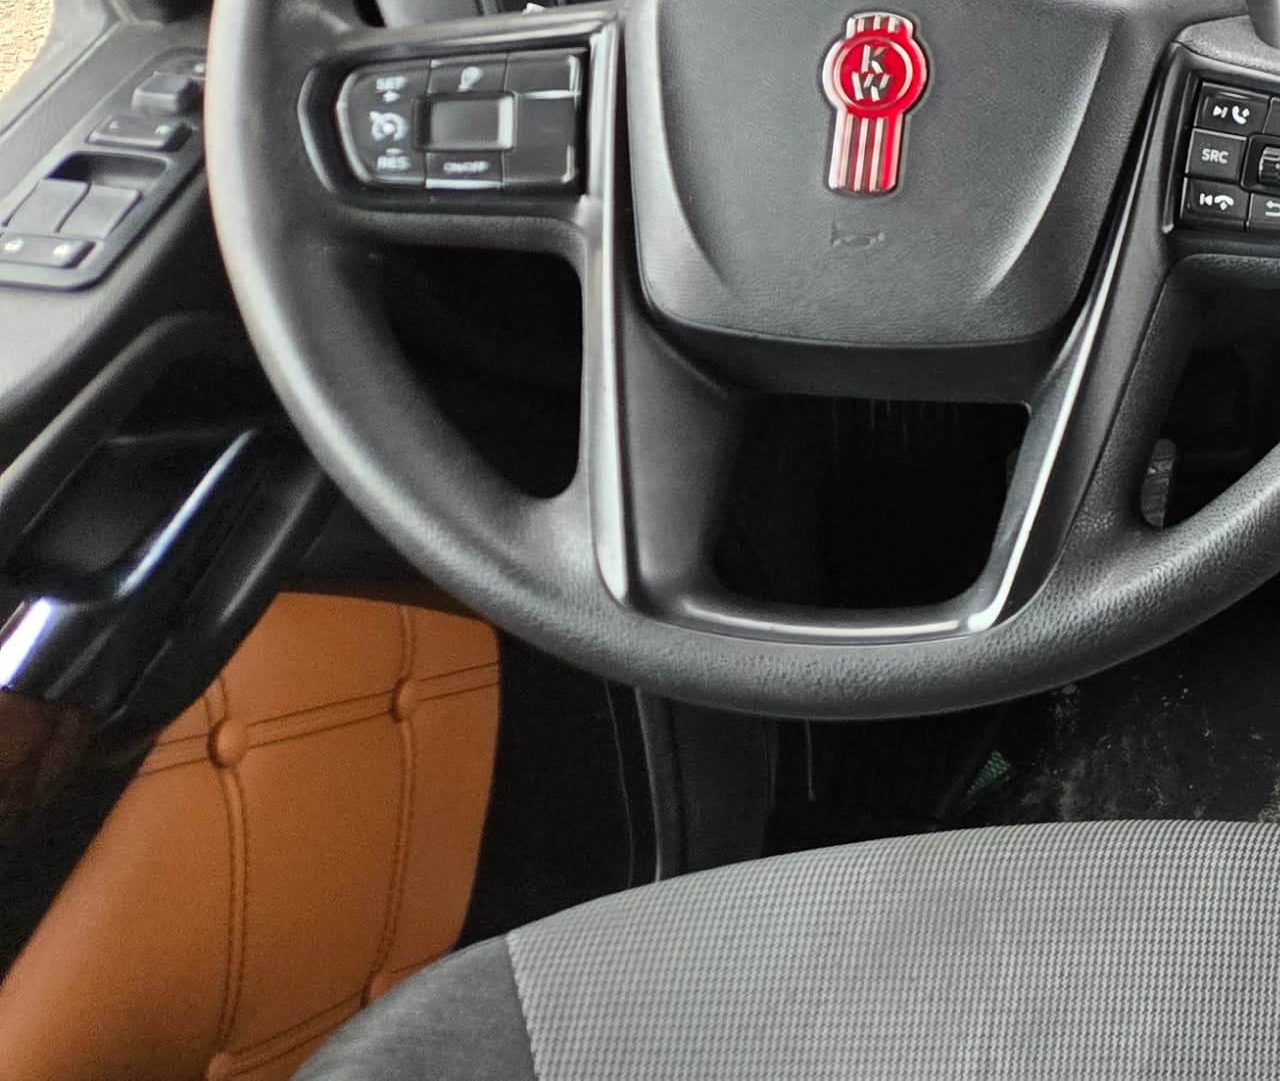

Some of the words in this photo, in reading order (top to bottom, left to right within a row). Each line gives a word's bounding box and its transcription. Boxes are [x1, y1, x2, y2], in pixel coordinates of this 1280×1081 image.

[861, 44, 886, 73] K
[851, 71, 893, 103] W
[1201, 147, 1230, 165] SRC
